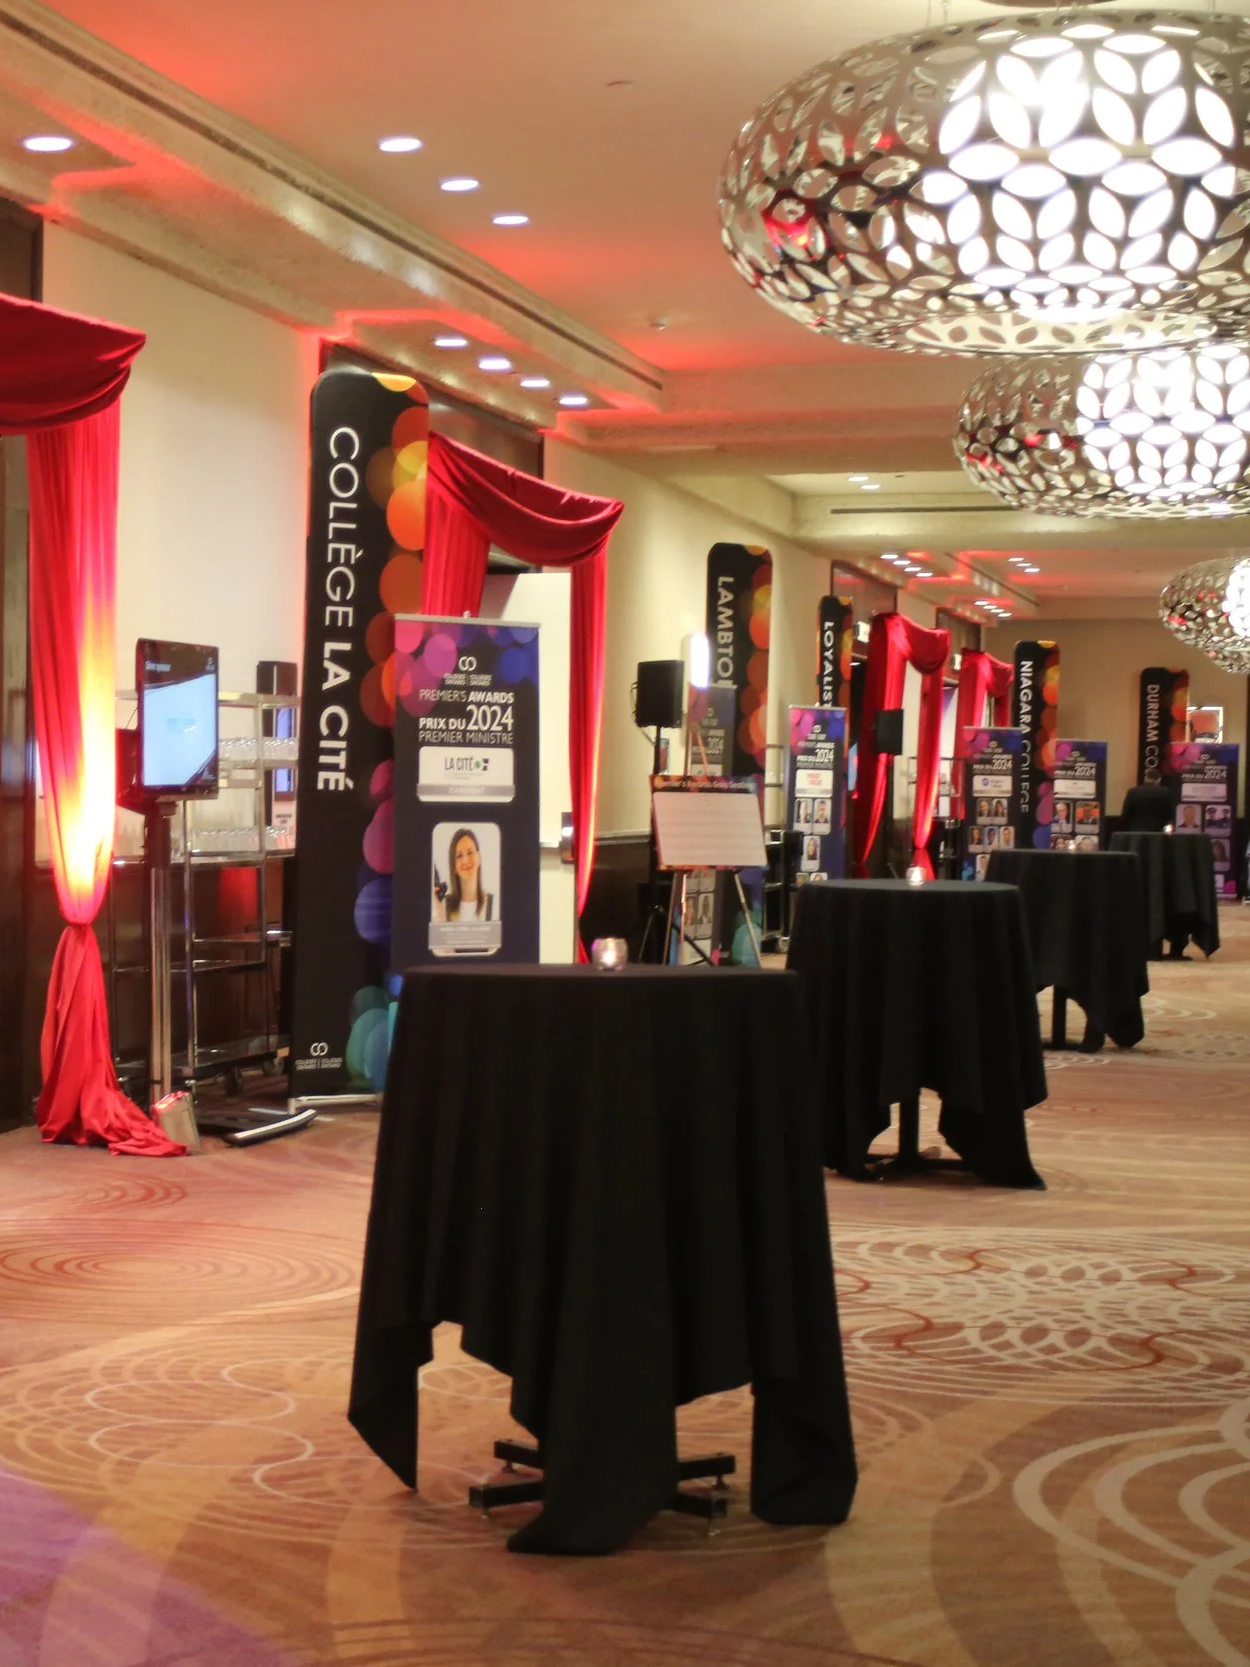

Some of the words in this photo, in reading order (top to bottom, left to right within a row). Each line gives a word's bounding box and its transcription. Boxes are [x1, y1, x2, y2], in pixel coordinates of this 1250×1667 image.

[325, 427, 363, 628] COLLÈGE
[322, 642, 352, 691] LA
[419, 717, 447, 729] PRIX
[448, 718, 466, 729] DU
[466, 705, 514, 731] 2024
[468, 691, 514, 704] AWARDS
[1019, 661, 1033, 734] NIAGARA
[1146, 684, 1160, 742] DURHAM
[317, 705, 354, 791] CITÉ
[418, 731, 463, 743] PREMIER
[466, 732, 514, 744] MINISTRE
[815, 749, 834, 762] 2024
